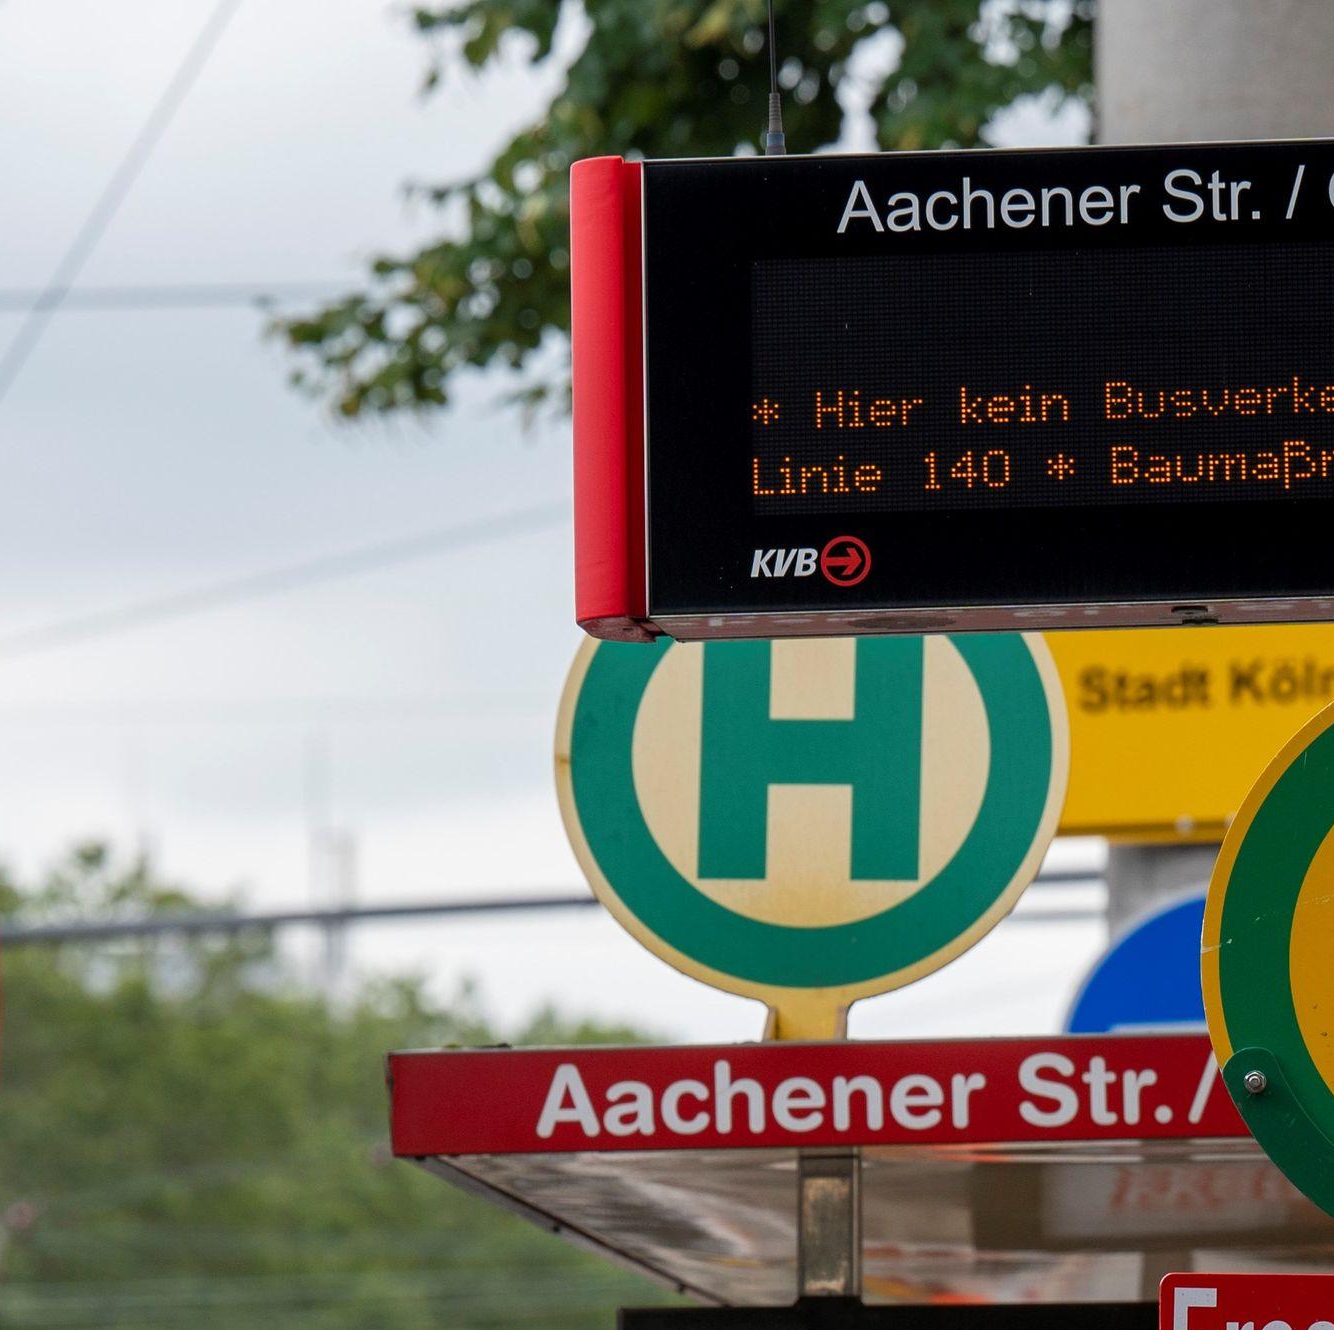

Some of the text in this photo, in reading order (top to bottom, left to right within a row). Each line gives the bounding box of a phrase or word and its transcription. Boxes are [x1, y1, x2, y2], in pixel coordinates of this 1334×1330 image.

[836, 171, 1142, 234] Aachener
[1162, 168, 1262, 223] Str.
[1285, 164, 1306, 220] /
[815, 387, 924, 428] Hier
[959, 383, 1069, 425] kein
[751, 455, 881, 495] Linie
[924, 449, 1011, 490] 140
[750, 547, 819, 578] KVB
[1078, 664, 1210, 712] Stadt
[697, 638, 924, 882] H
[536, 1059, 989, 1139] Aachener
[1018, 1052, 1173, 1128] Str.
